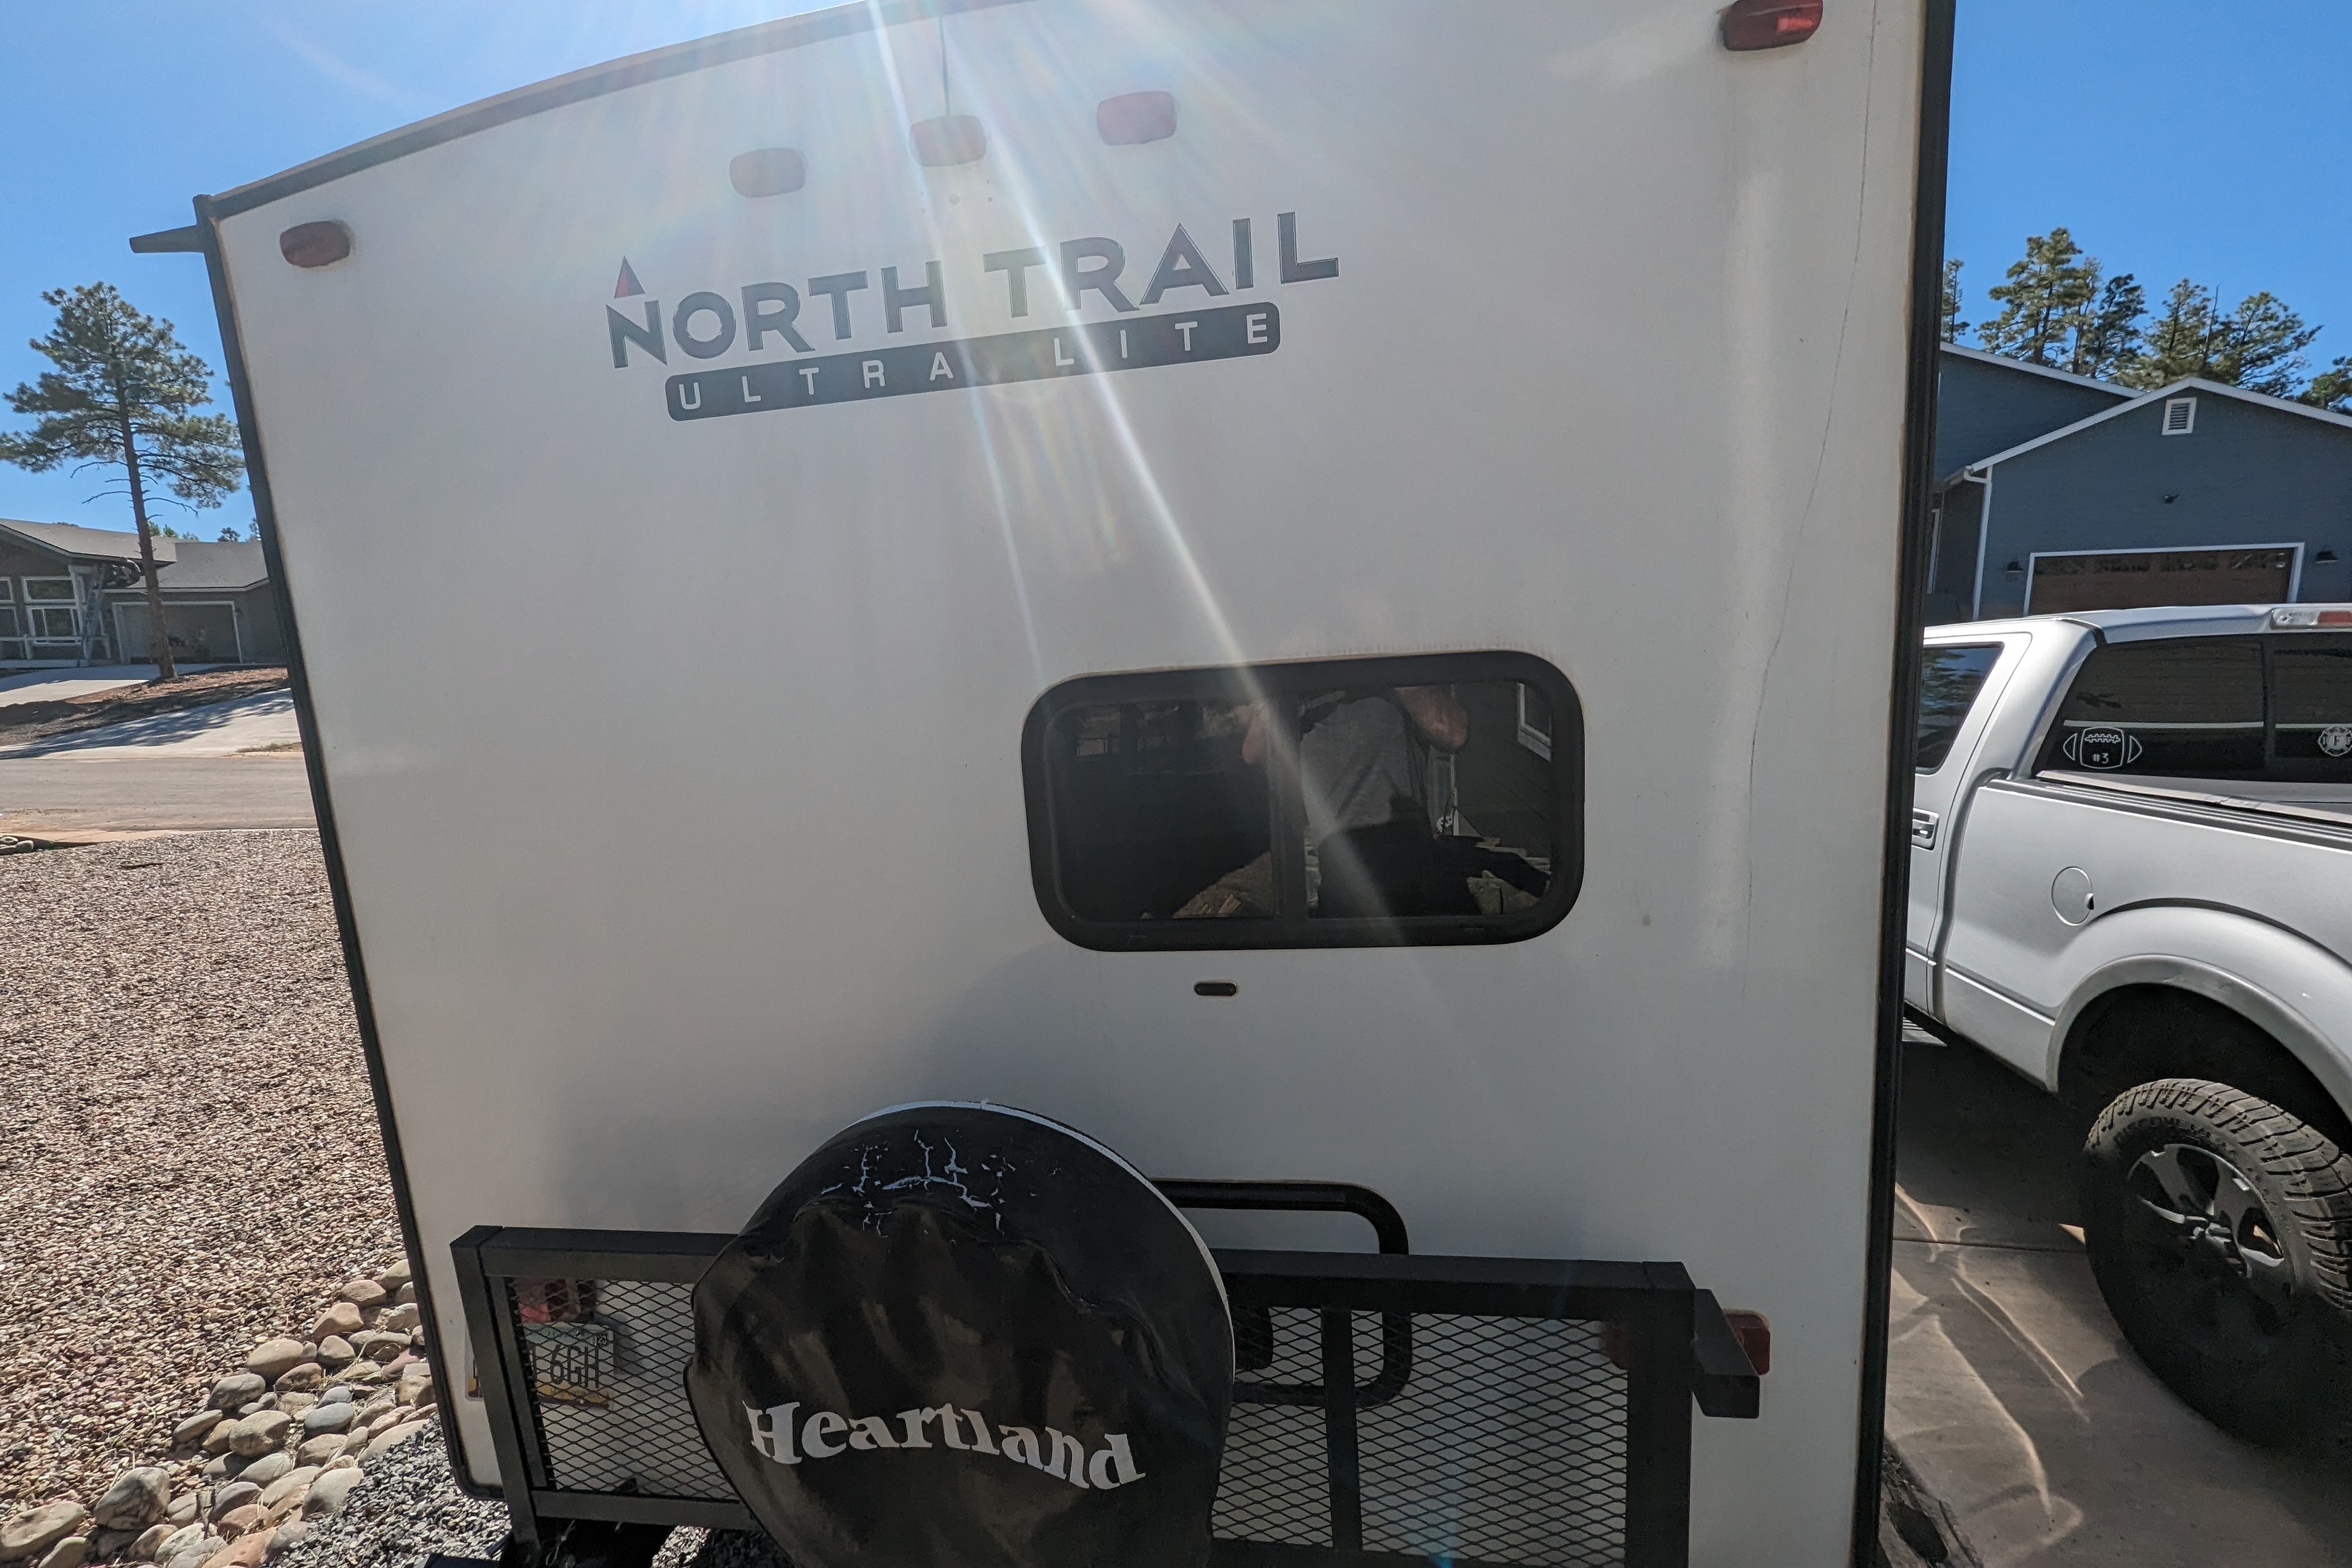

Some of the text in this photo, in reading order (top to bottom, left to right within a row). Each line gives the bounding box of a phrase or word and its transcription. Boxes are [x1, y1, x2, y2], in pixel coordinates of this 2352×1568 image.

[607, 212, 1339, 369] NORTH TRAIL
[679, 314, 1270, 410] ULTRA LITE
[2093, 753, 2109, 763] #3
[742, 1400, 1146, 1490] Heartland
